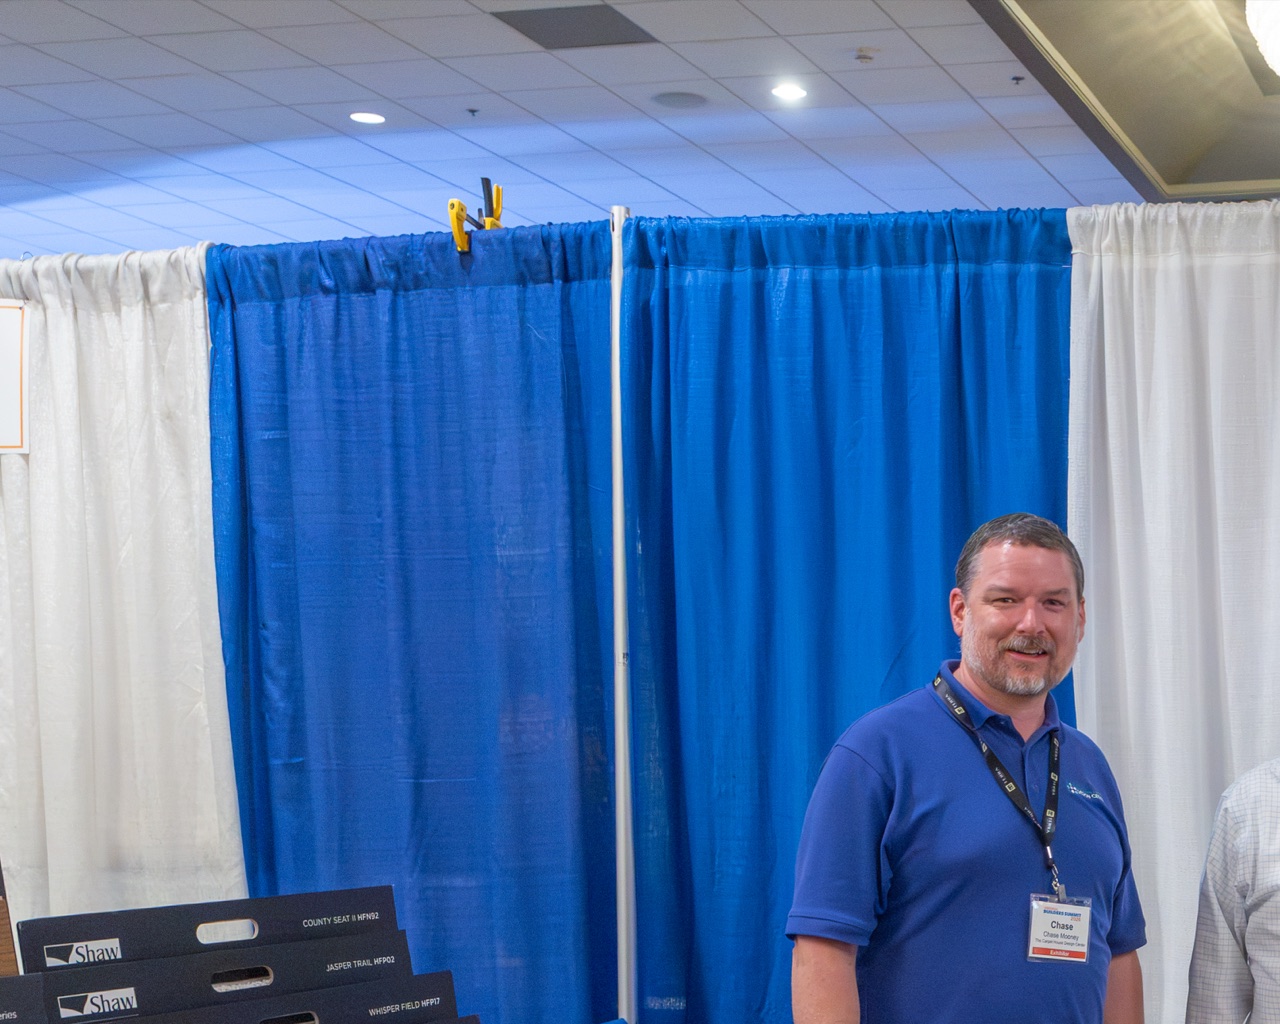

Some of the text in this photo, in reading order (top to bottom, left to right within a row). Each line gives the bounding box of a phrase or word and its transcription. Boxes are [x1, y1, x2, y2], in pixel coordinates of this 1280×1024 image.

[302, 917, 332, 927] COUNTY
[333, 914, 350, 924] SEAT
[357, 912, 379, 921] HFN92
[1051, 920, 1073, 930] Chase
[75, 945, 119, 963] Shaw
[326, 956, 395, 972] JASPER TRAIL HFP02
[90, 995, 135, 1013] Shaw
[368, 997, 440, 1016] WHISPER FIELD HFP17
